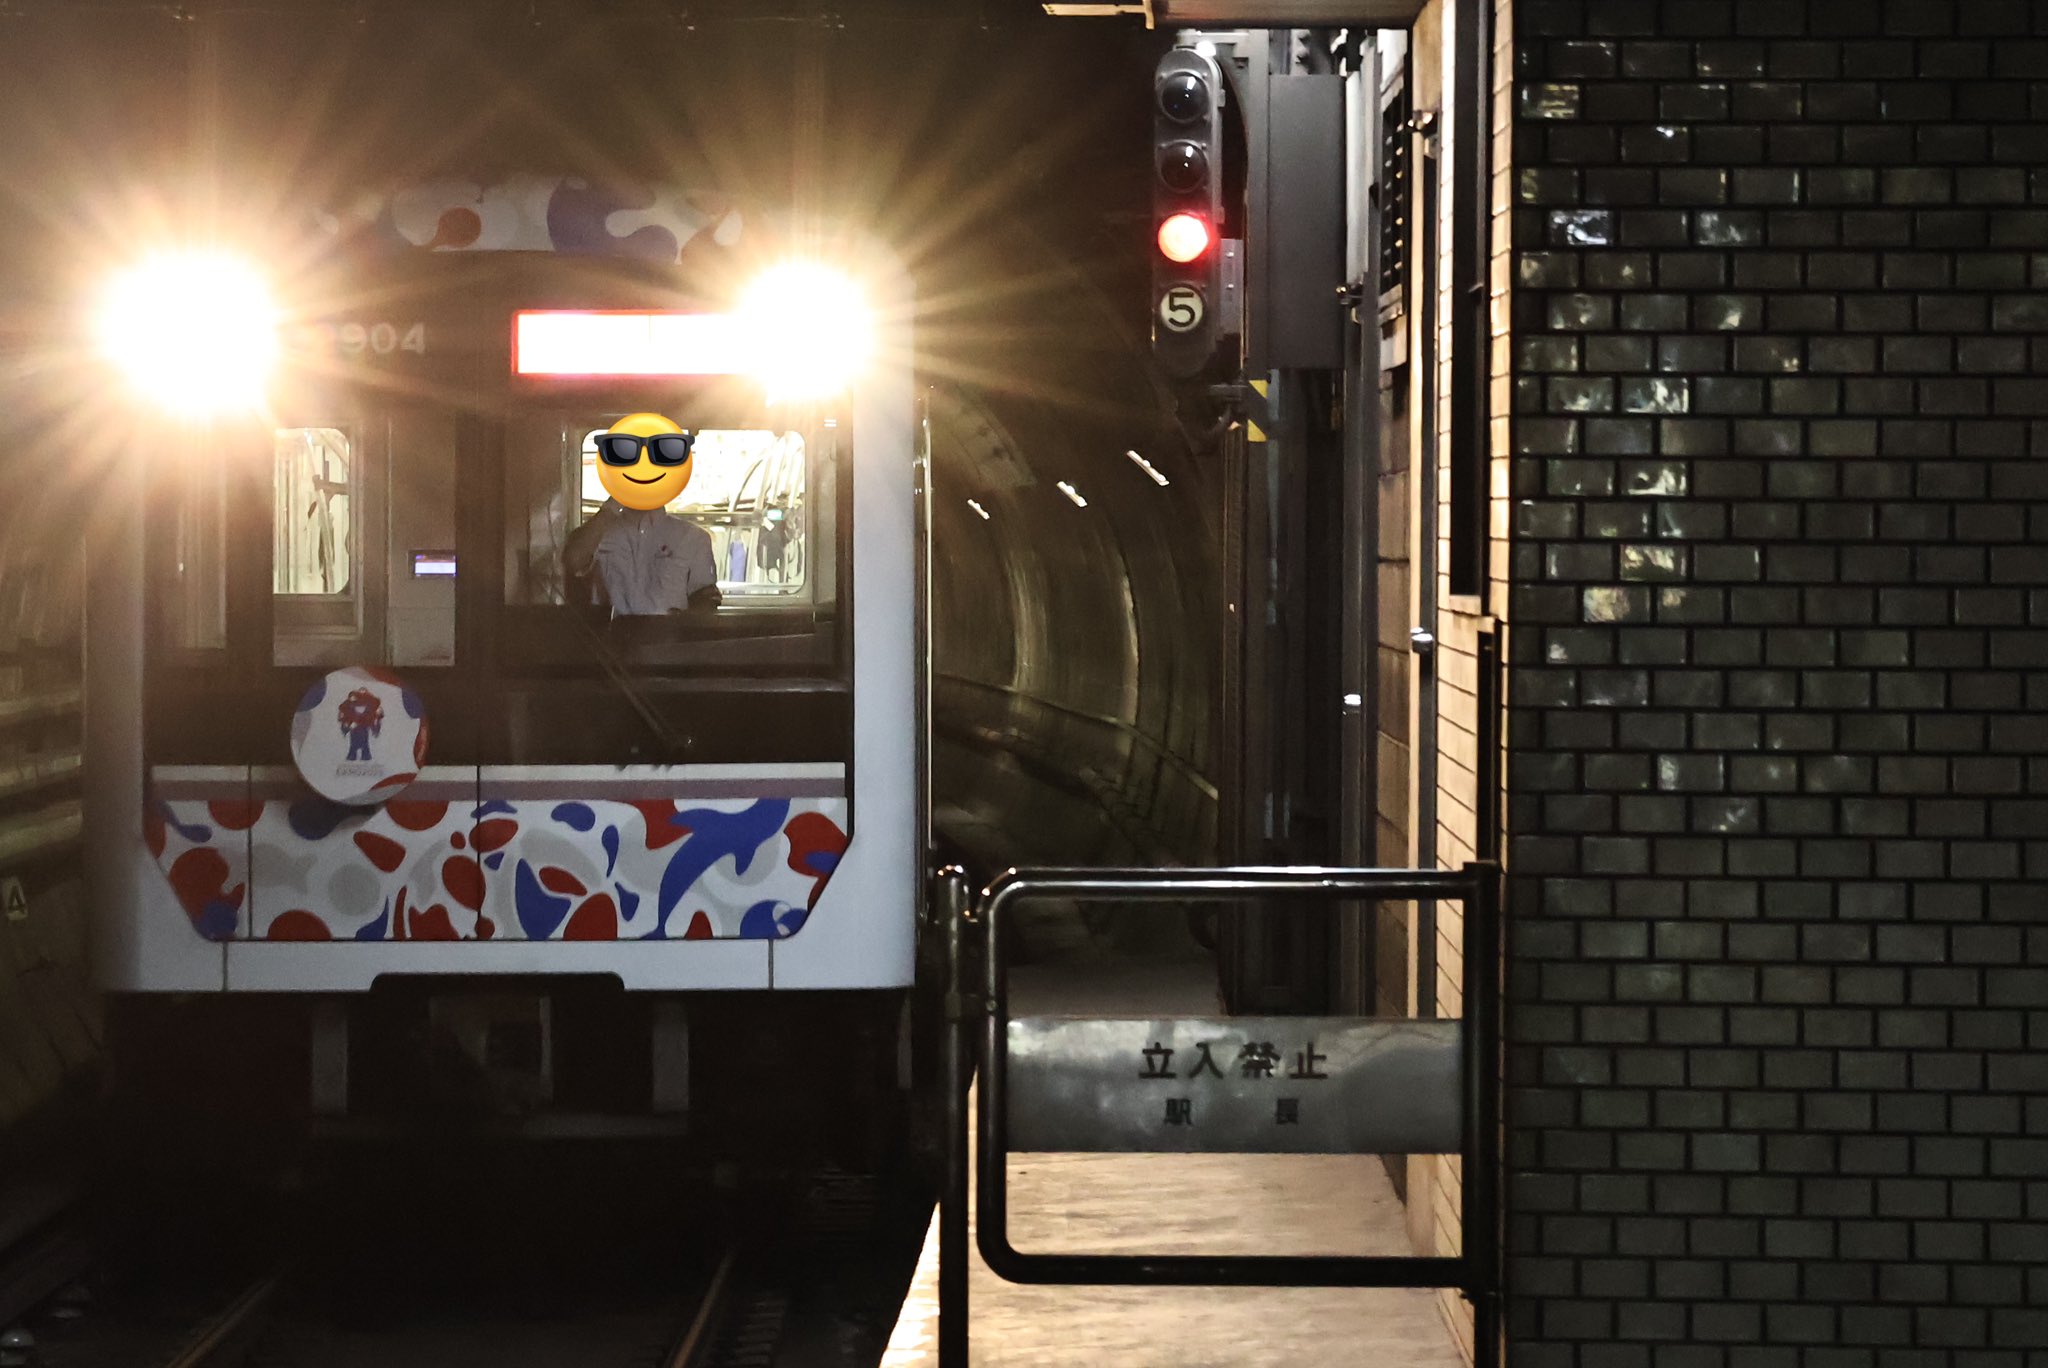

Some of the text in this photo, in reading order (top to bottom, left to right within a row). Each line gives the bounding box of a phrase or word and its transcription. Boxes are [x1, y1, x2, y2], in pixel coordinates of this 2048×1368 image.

[1168, 291, 1196, 328] 5
[1138, 1041, 1329, 1080] 立入禁止
